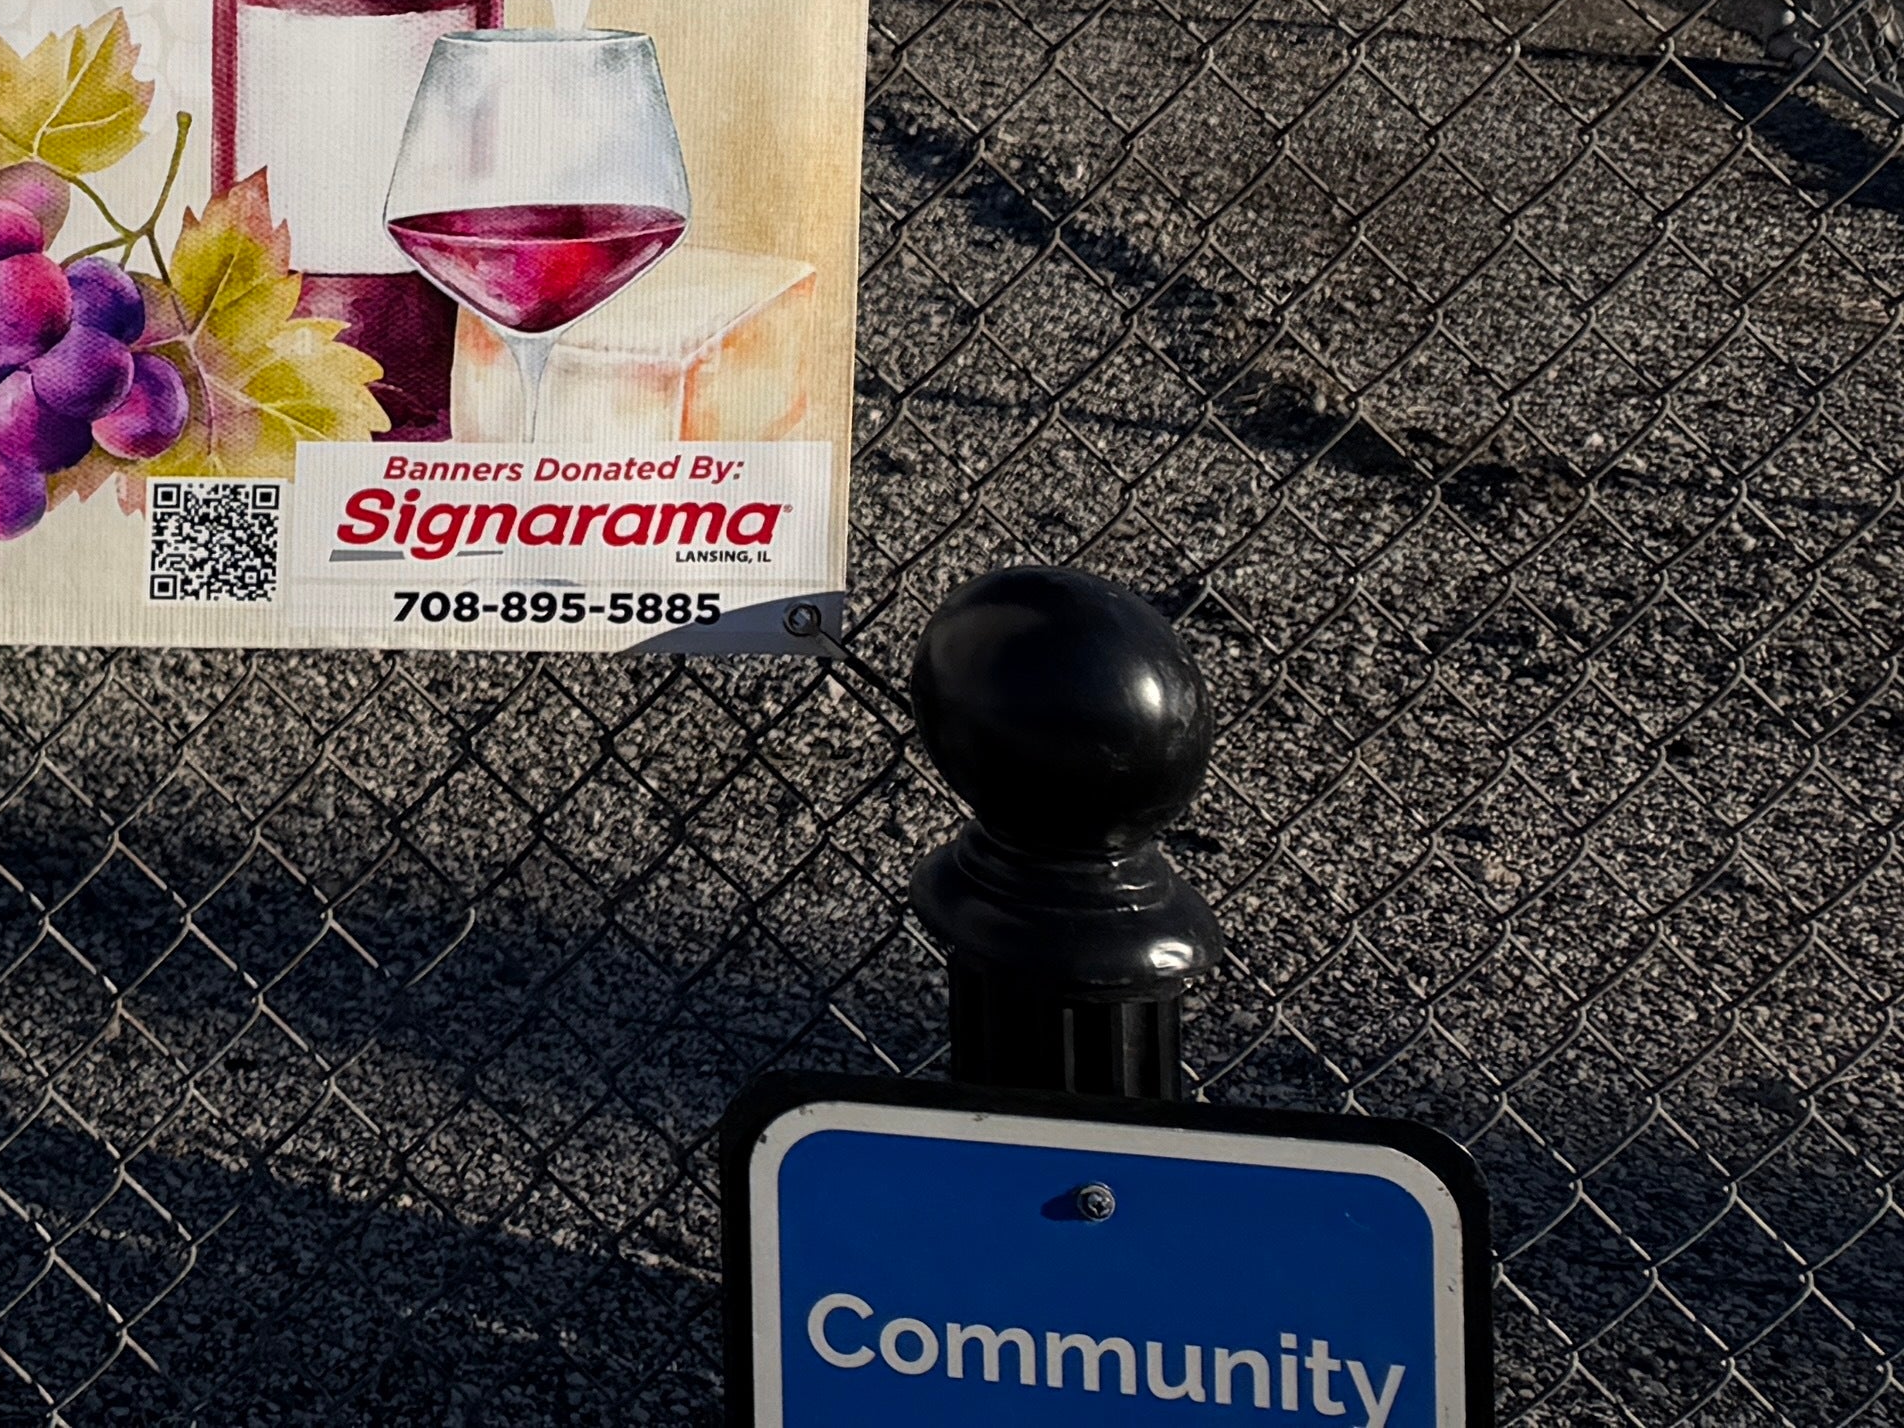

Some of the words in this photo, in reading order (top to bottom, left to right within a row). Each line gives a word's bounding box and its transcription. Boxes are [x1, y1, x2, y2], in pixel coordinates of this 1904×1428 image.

[384, 456, 523, 482] Banners
[535, 455, 680, 482] Donated
[690, 455, 744, 482] By:
[336, 488, 782, 561] Signarama
[675, 550, 753, 564] LANSING,
[757, 550, 772, 563] IL
[393, 591, 721, 626] 708-895-5885
[807, 1293, 1406, 1428] Community
